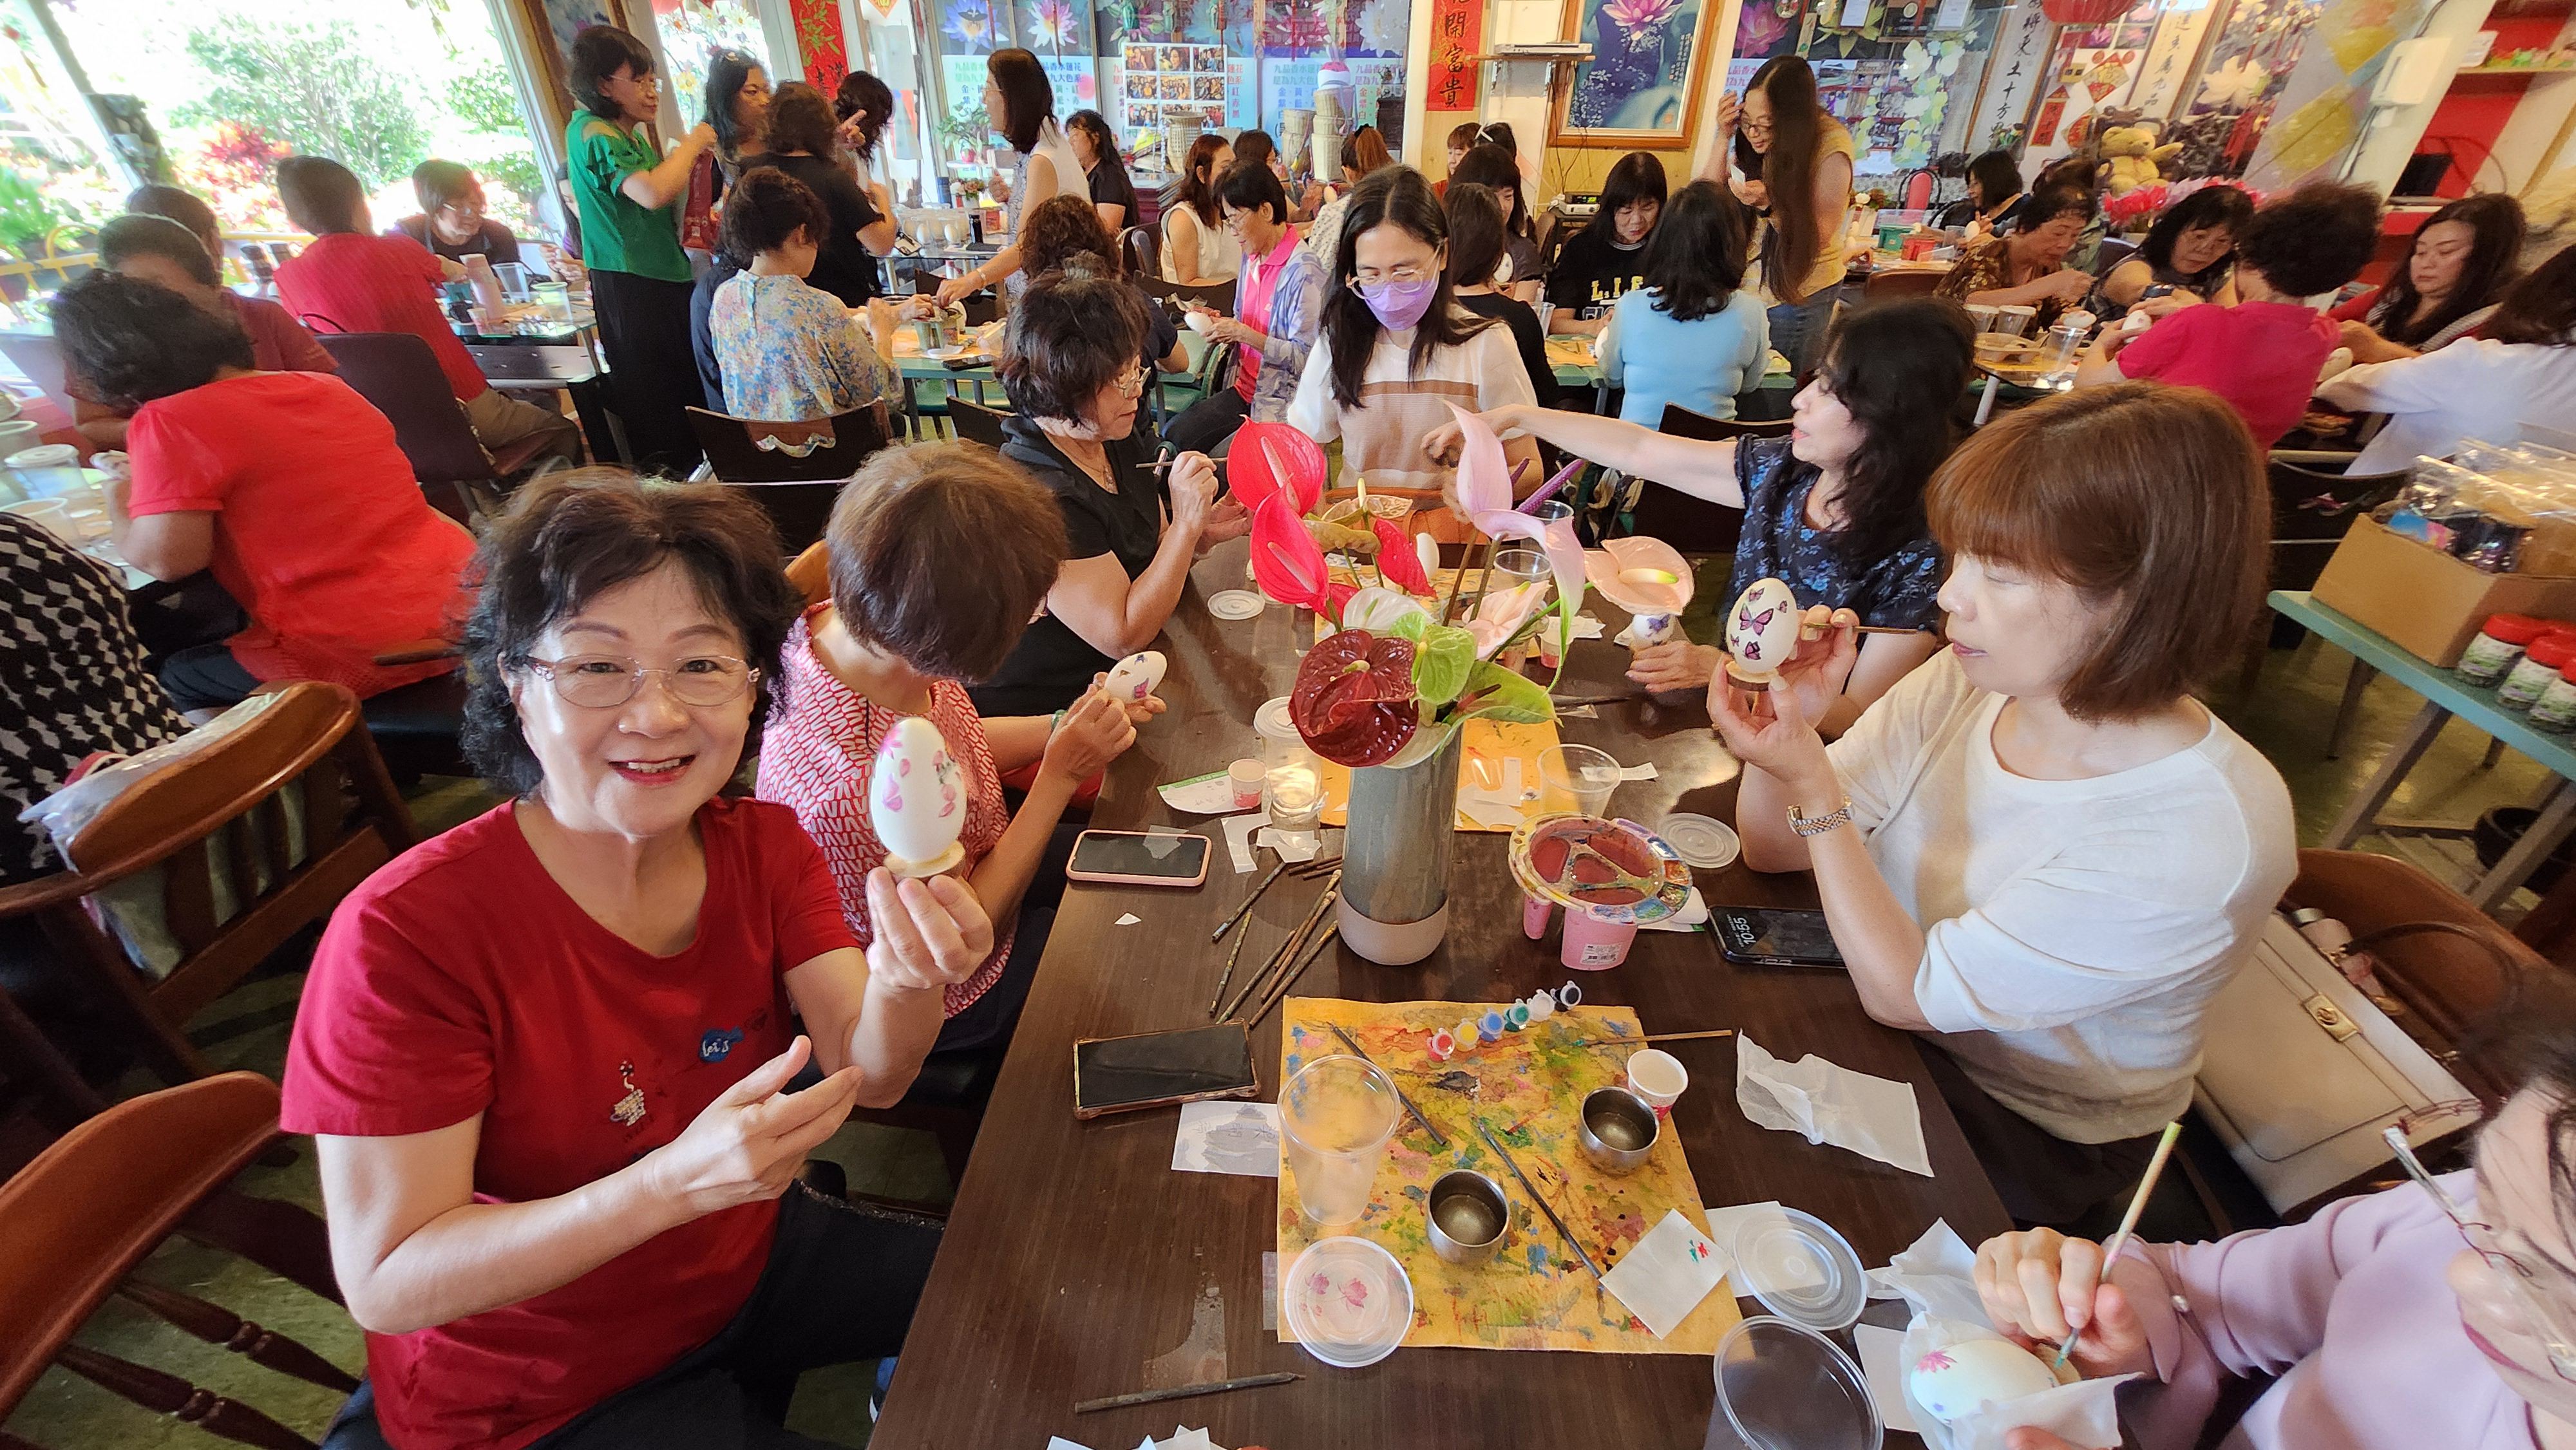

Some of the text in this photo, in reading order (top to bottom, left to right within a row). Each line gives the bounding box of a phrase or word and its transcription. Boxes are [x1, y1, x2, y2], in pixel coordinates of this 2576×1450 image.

[1439, 0, 1470, 108] 開富貴
[1733, 918, 1757, 945] 10:55
